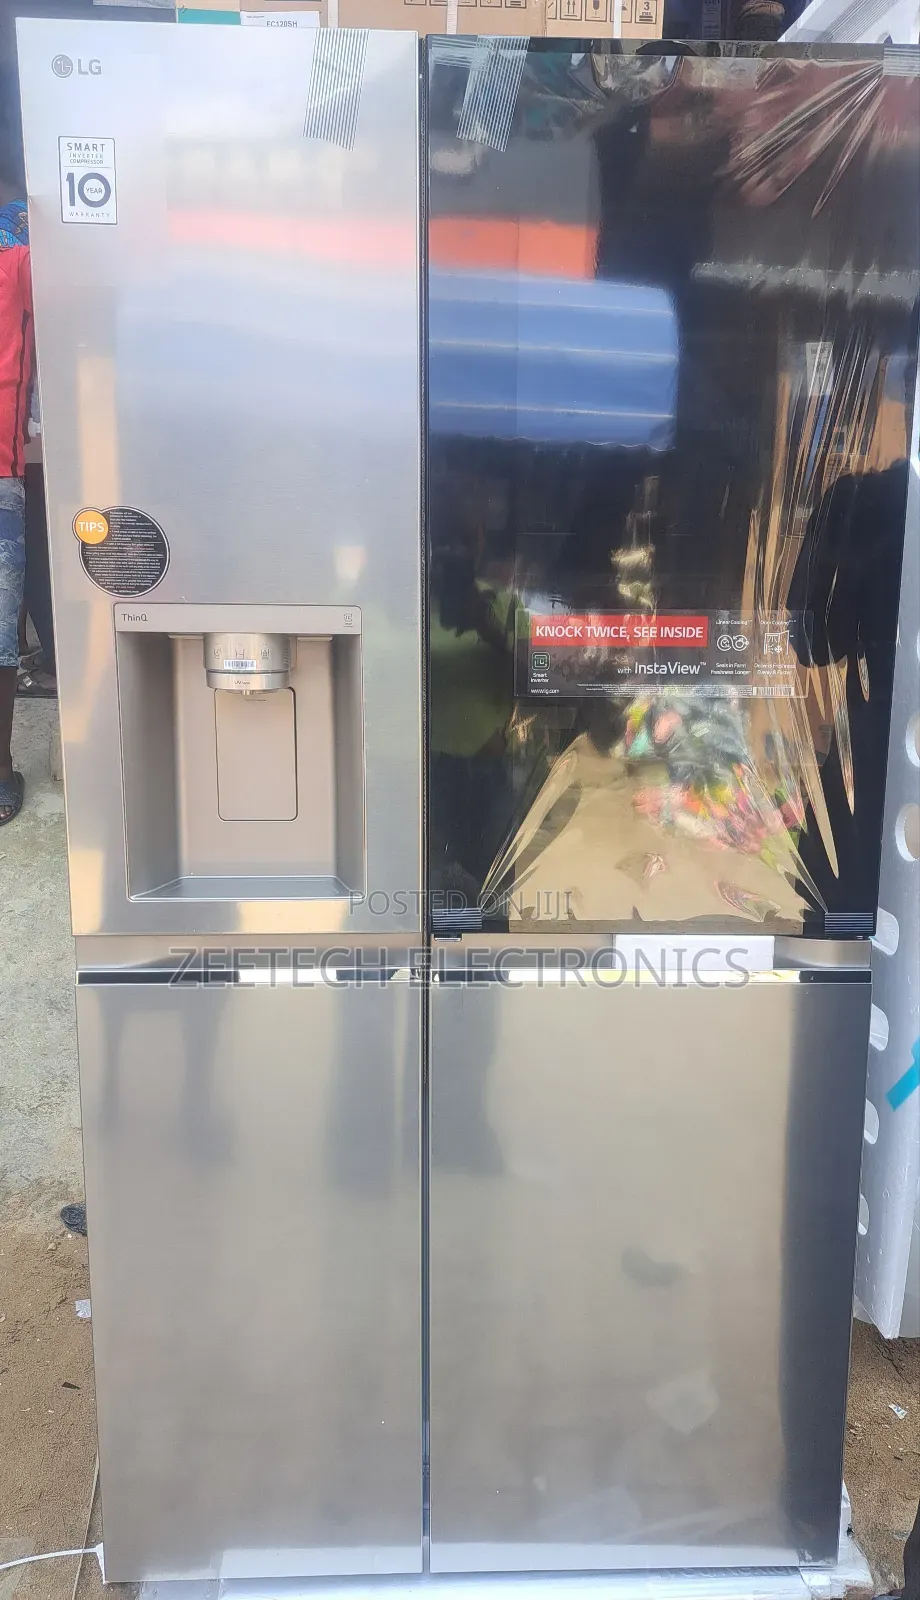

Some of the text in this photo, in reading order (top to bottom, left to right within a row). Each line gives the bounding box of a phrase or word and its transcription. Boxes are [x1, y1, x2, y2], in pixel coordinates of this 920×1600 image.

[643, 1, 650, 11] 3
[77, 58, 102, 76] LG
[66, 142, 106, 153] SMART
[65, 172, 112, 208] 10
[77, 521, 105, 533] TIPS
[121, 613, 148, 622] ThinQ
[535, 625, 704, 642] KNOCK TWICE, SEE INSIDE
[617, 666, 632, 674] with
[734, 669, 751, 677] Longer
